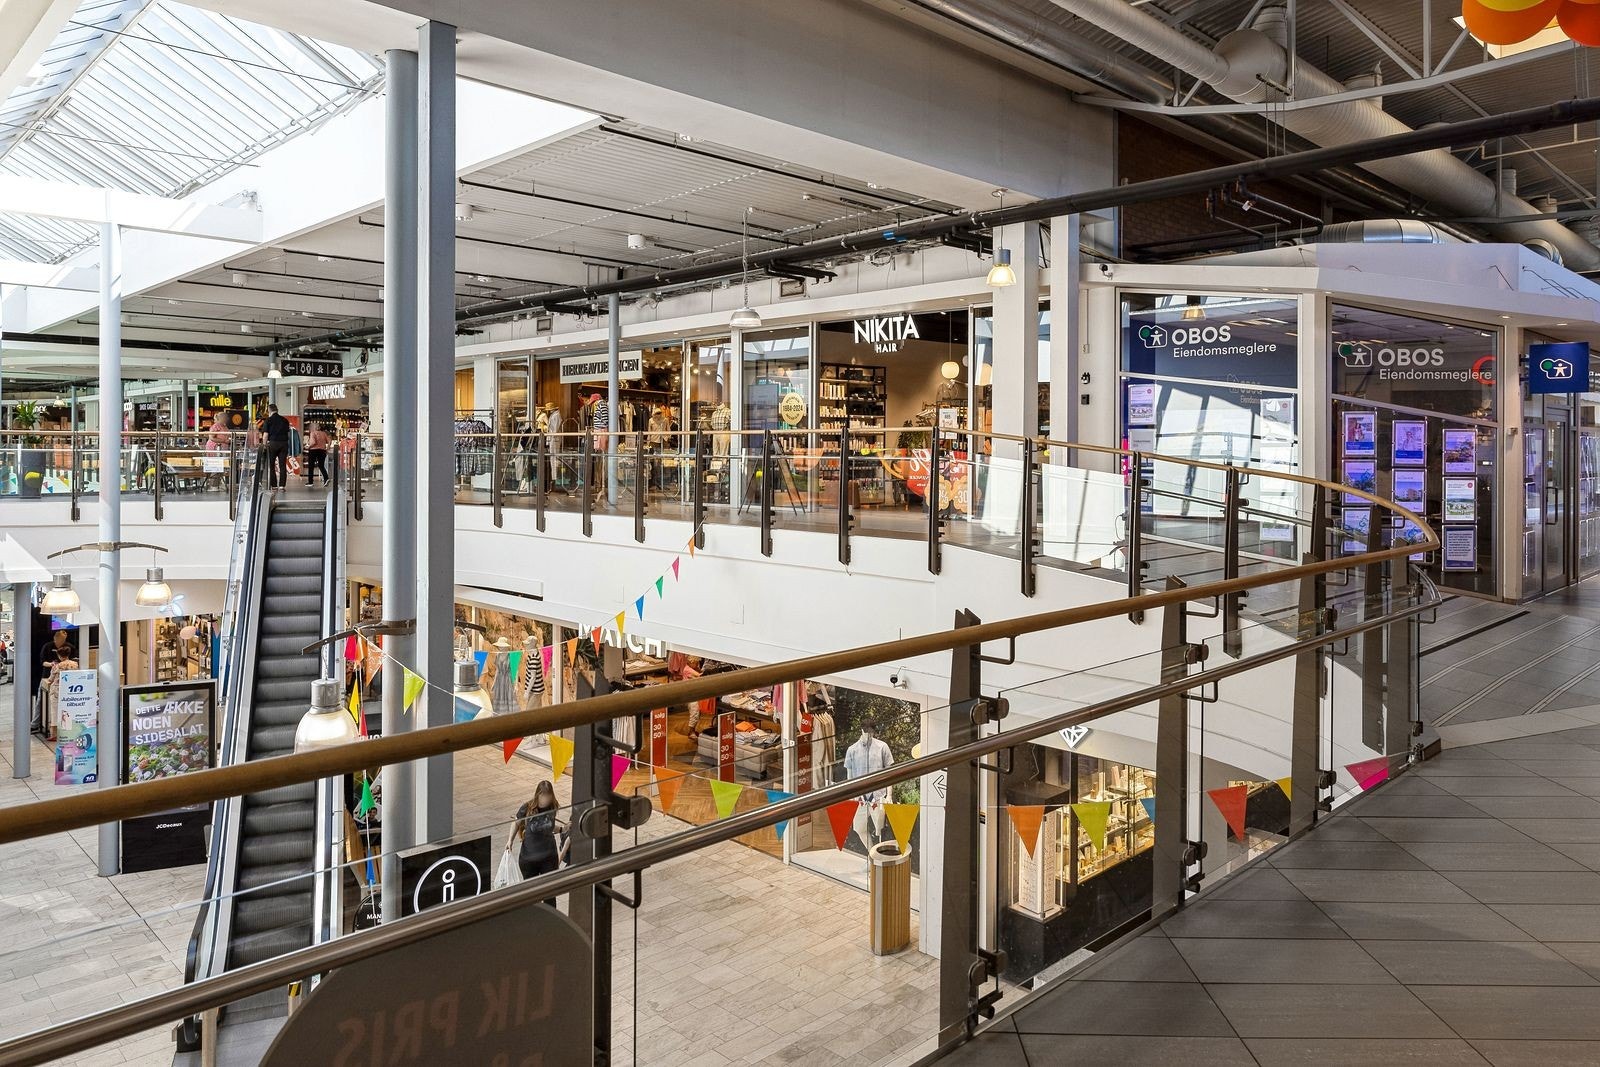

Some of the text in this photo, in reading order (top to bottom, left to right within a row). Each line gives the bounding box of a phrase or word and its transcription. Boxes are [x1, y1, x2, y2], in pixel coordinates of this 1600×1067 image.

[854, 314, 920, 344] NIKITA
[1171, 325, 1231, 346] OBOS
[875, 343, 898, 354] HAIR
[1173, 342, 1277, 358] Eiendomsmeglere
[1377, 348, 1444, 366] OBOS
[562, 359, 639, 377] HERREAVDENGEN
[1379, 368, 1492, 382] Eiendomsmeglere
[210, 394, 232, 407] nille
[135, 701, 204, 715] DETTE ÆKKE
[132, 716, 172, 731] NOEN
[135, 723, 204, 745] SIDESALAT
[155, 822, 183, 830] JCDecaux
